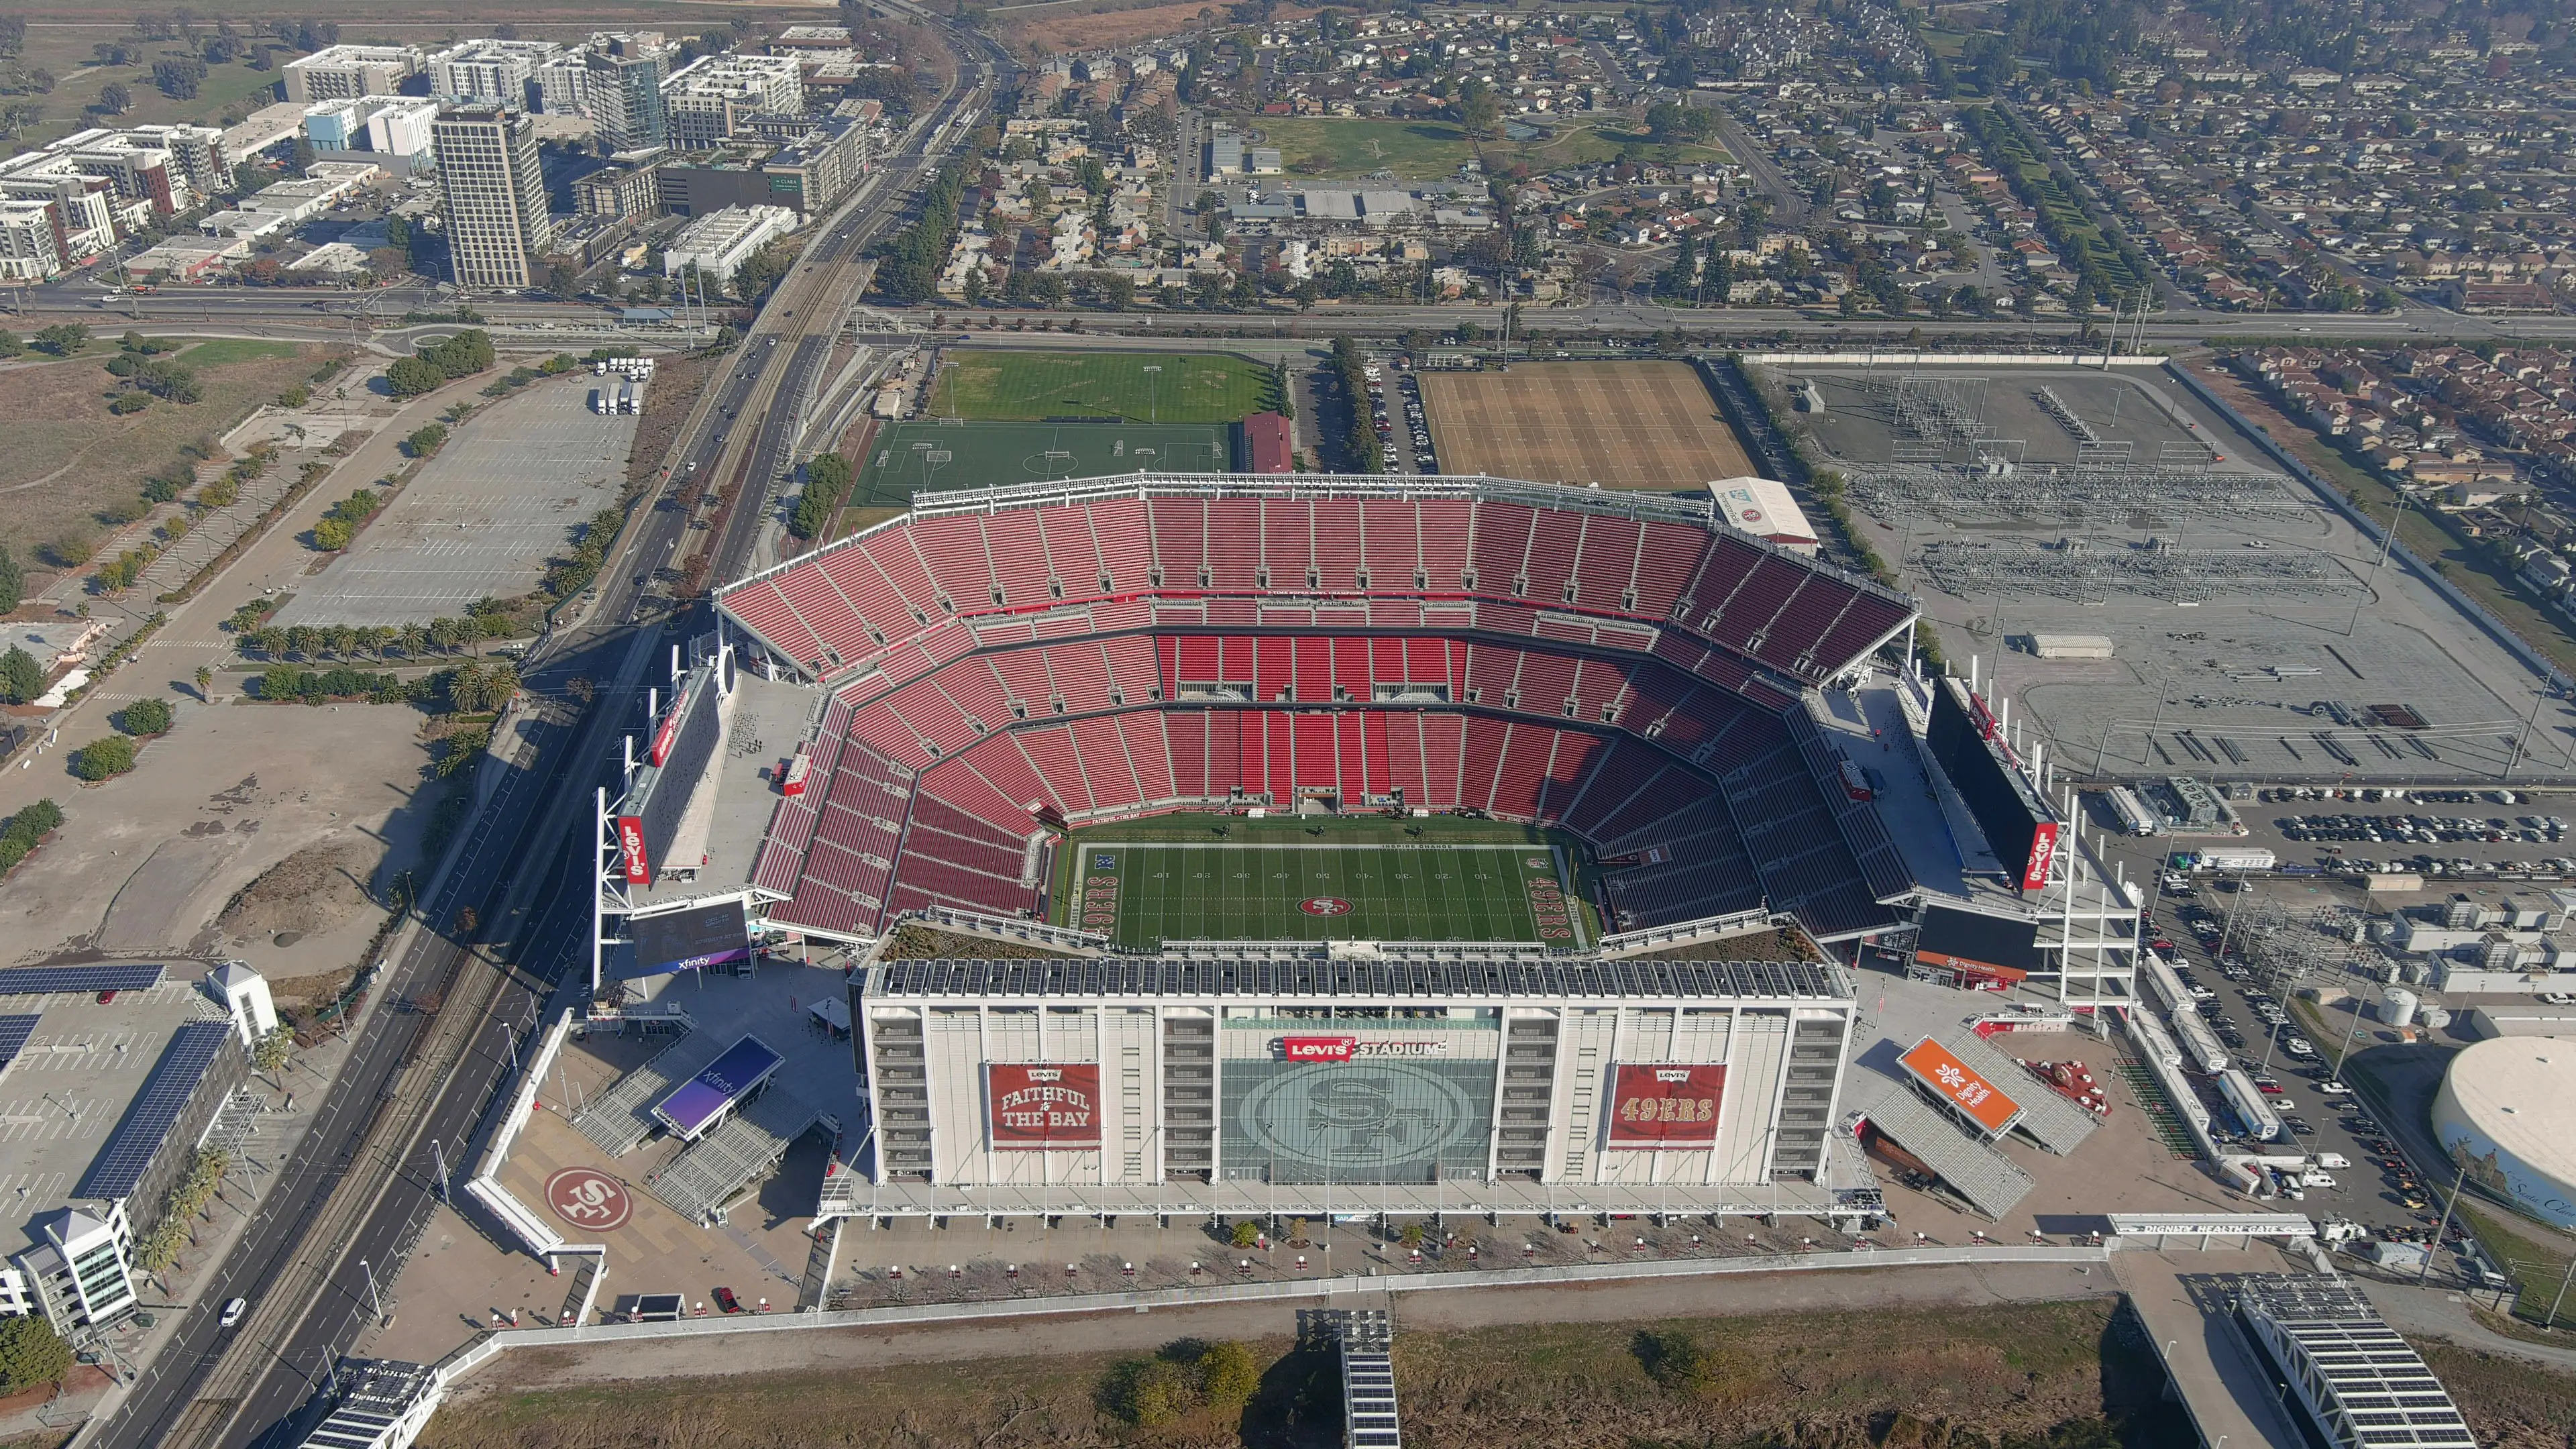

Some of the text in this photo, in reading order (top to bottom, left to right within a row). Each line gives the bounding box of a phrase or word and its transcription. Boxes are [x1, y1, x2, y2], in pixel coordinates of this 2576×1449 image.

[1092, 816, 1116, 824] FAITHFUL
[1535, 820, 1560, 829] FAITHFUL
[1527, 877, 1571, 938] 49ERS
[678, 957, 710, 969] xfinity
[1959, 962, 1996, 973] Dignity Health
[1358, 1044, 1440, 1055] STADIUM
[703, 1070, 737, 1095] xfinity
[1956, 1080, 1982, 1100] Dignity
[1002, 1087, 1090, 1111] FAITHFUL
[1967, 1089, 1990, 1108] Health
[1620, 1097, 1713, 1122] 49ERS
[1002, 1112, 1090, 1126] THE BAY
[2510, 1183, 2539, 1203] Santa
[2248, 1225, 2279, 1233] GATE
